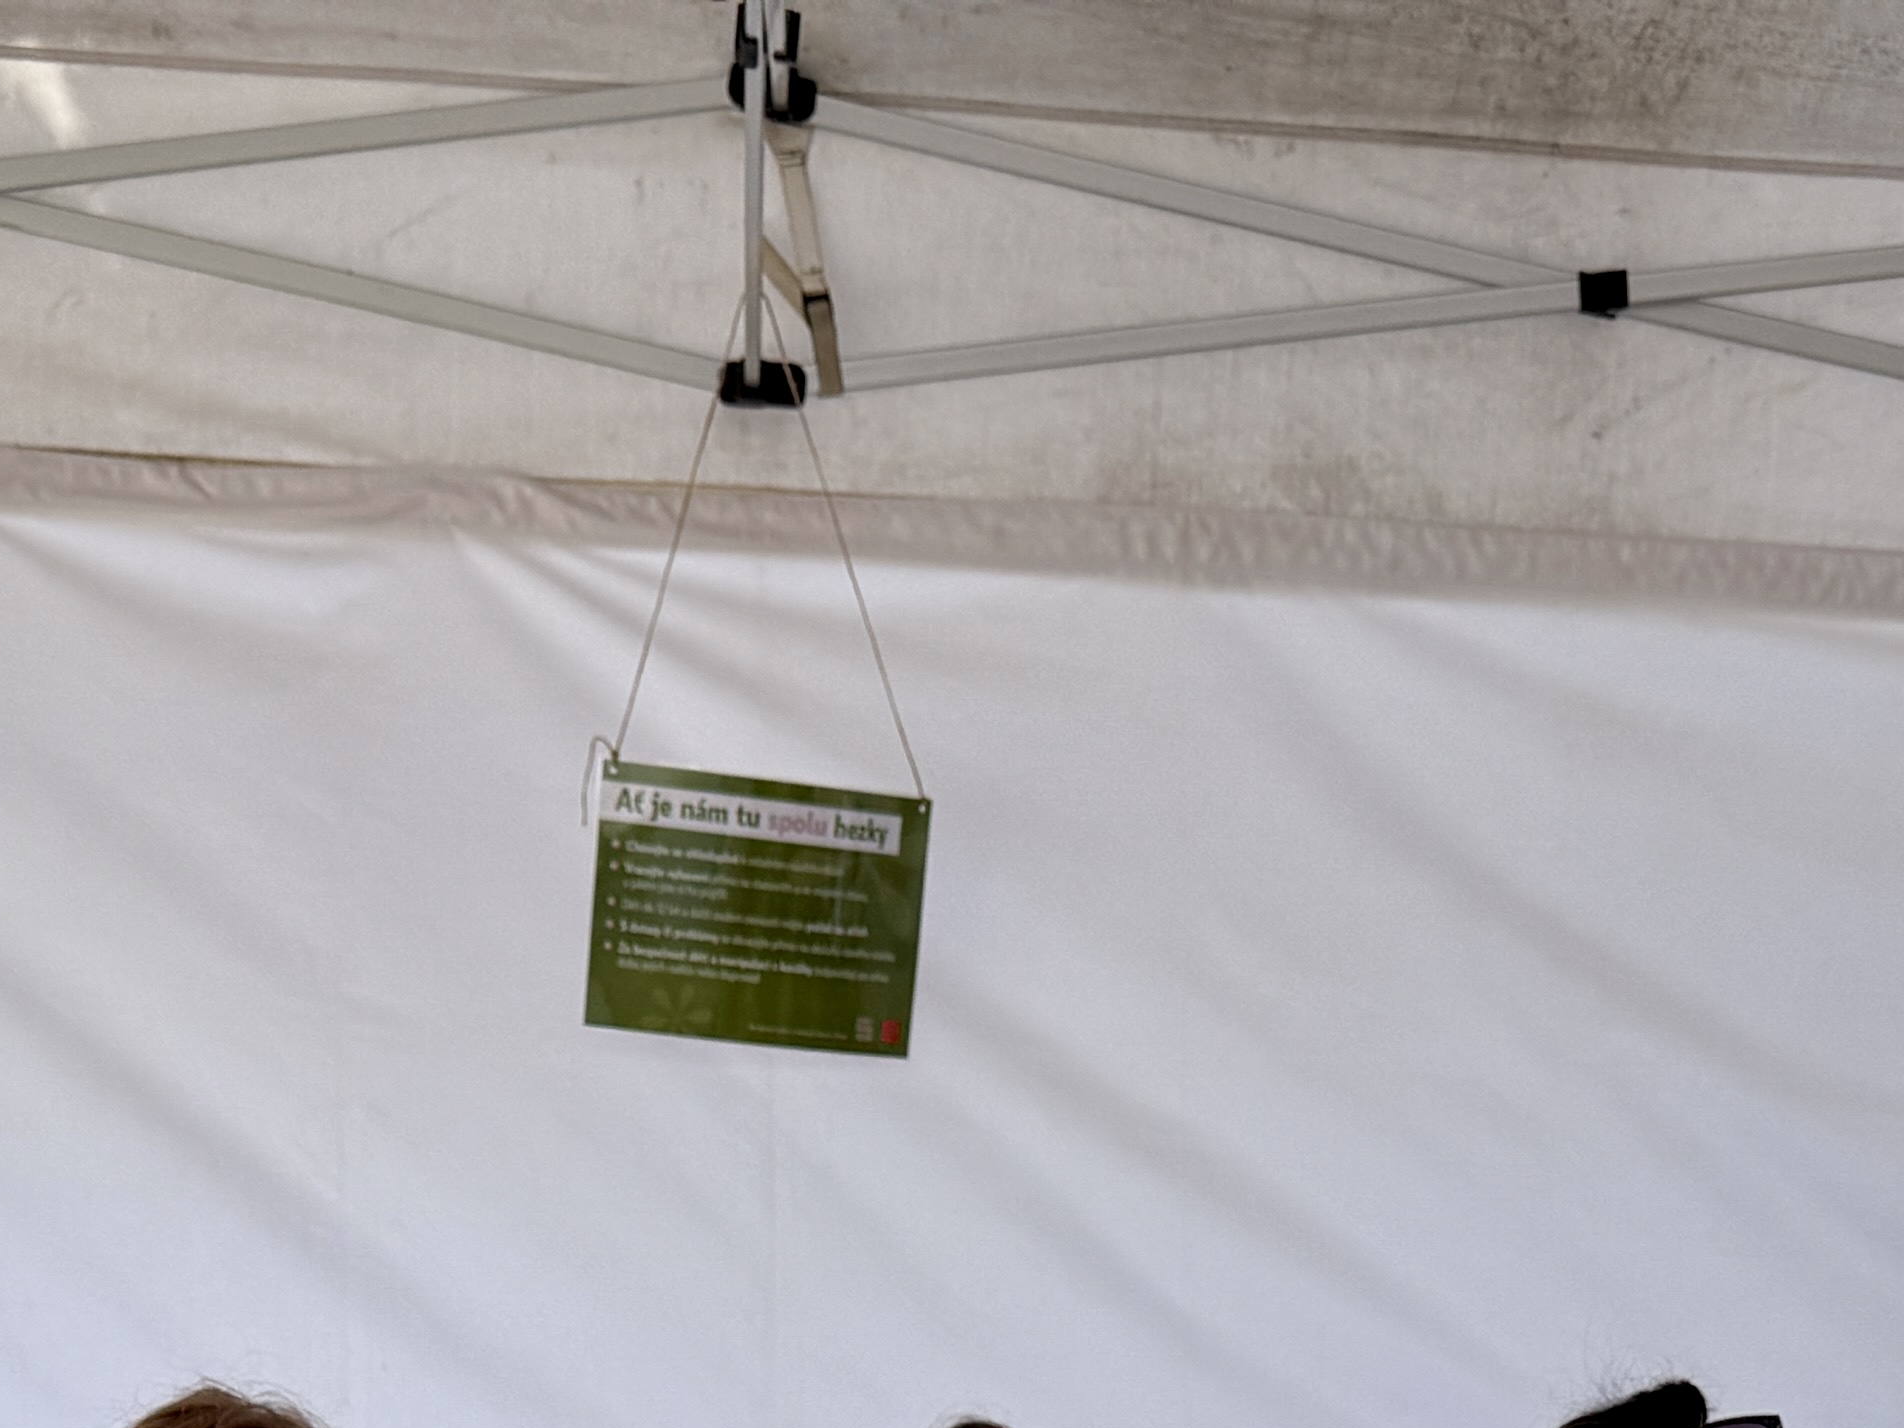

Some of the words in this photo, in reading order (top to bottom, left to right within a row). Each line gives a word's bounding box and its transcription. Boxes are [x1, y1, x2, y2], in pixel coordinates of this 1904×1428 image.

[651, 791, 672, 821] je
[680, 798, 728, 825] nám
[737, 804, 761, 828] tu
[767, 811, 828, 840] spolu
[833, 813, 888, 850] hezky
